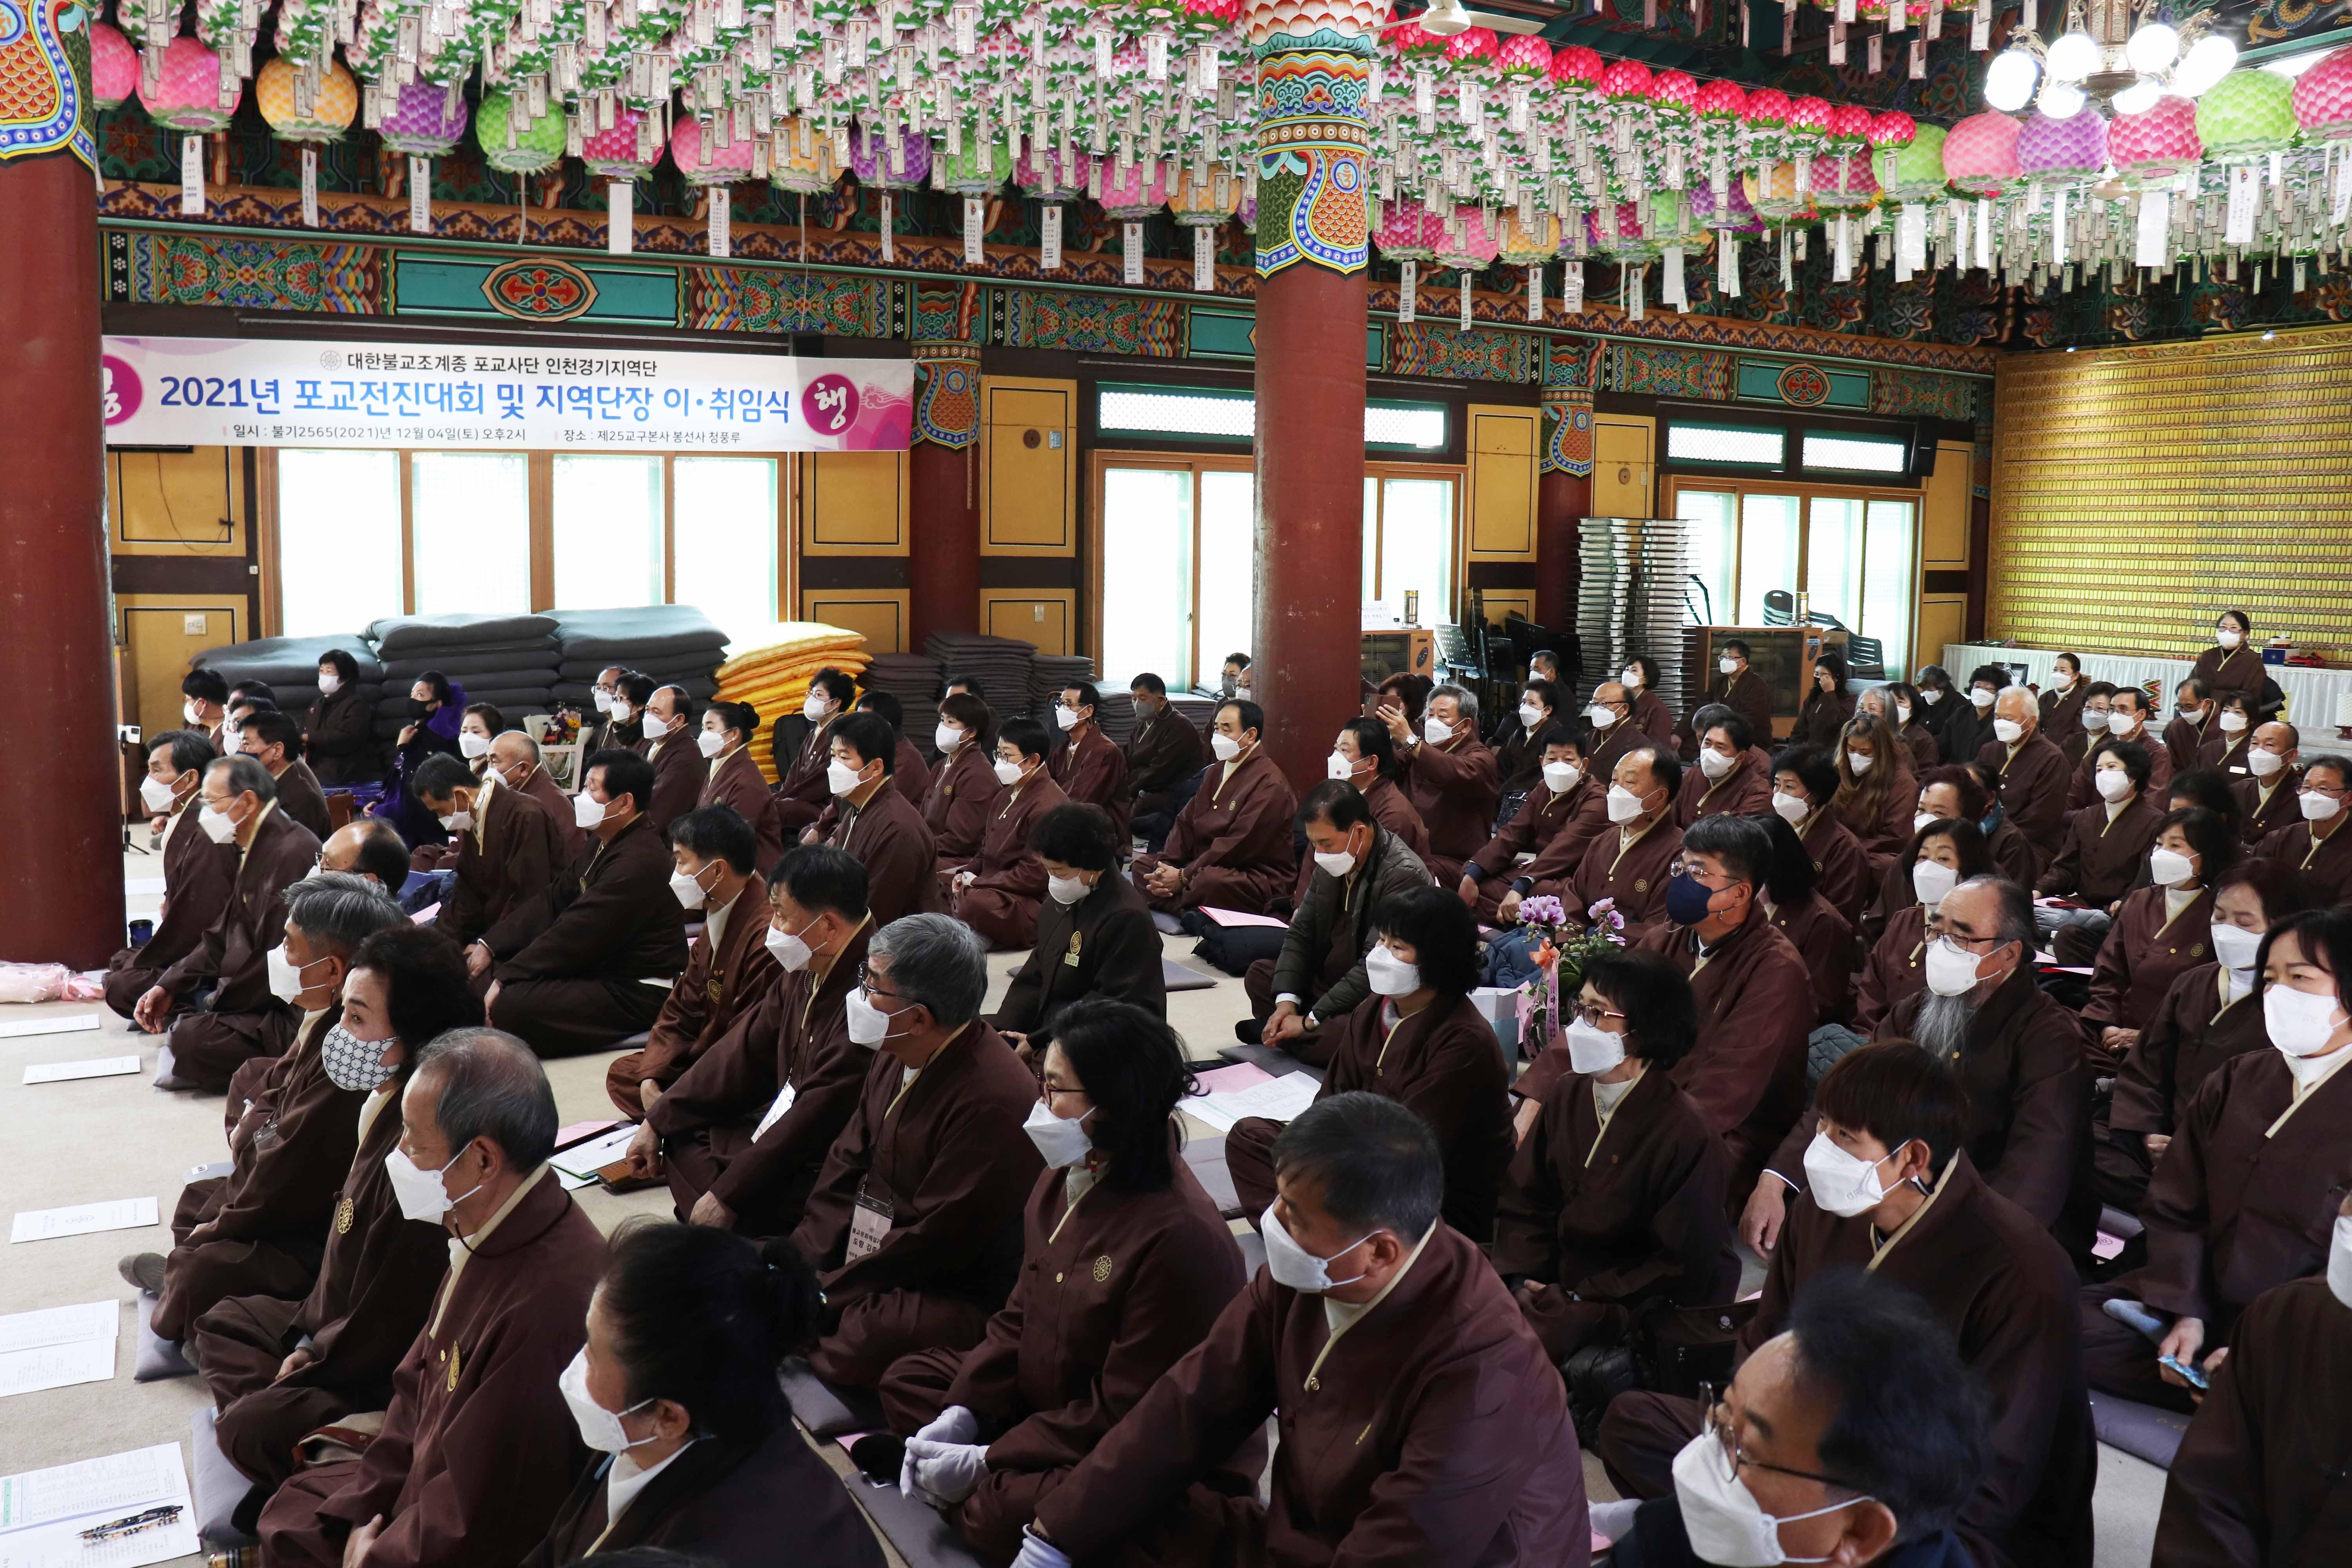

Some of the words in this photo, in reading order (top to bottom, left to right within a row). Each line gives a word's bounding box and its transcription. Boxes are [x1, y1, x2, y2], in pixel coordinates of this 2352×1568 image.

[348, 353, 467, 373] 대한불교조계종
[474, 357, 540, 375] 포교사단
[546, 358, 657, 377] 인천경기지역단
[161, 376, 281, 415] 2021년
[294, 380, 484, 417] 포교전진대회
[497, 384, 526, 420] 및
[536, 385, 655, 422] 지역단장
[814, 382, 848, 430] 행
[233, 425, 259, 438] 일시
[272, 425, 391, 441] 불기2565(2021)년
[397, 427, 424, 440] 12월
[428, 428, 479, 441] 04일(토)
[483, 428, 526, 442] 오후2시
[564, 429, 586, 443] 장소
[597, 430, 670, 443] 제25교구본사
[673, 431, 706, 444] 봉선사
[709, 432, 741, 445] 청풍루
[853, 1238, 864, 1248] 도향
